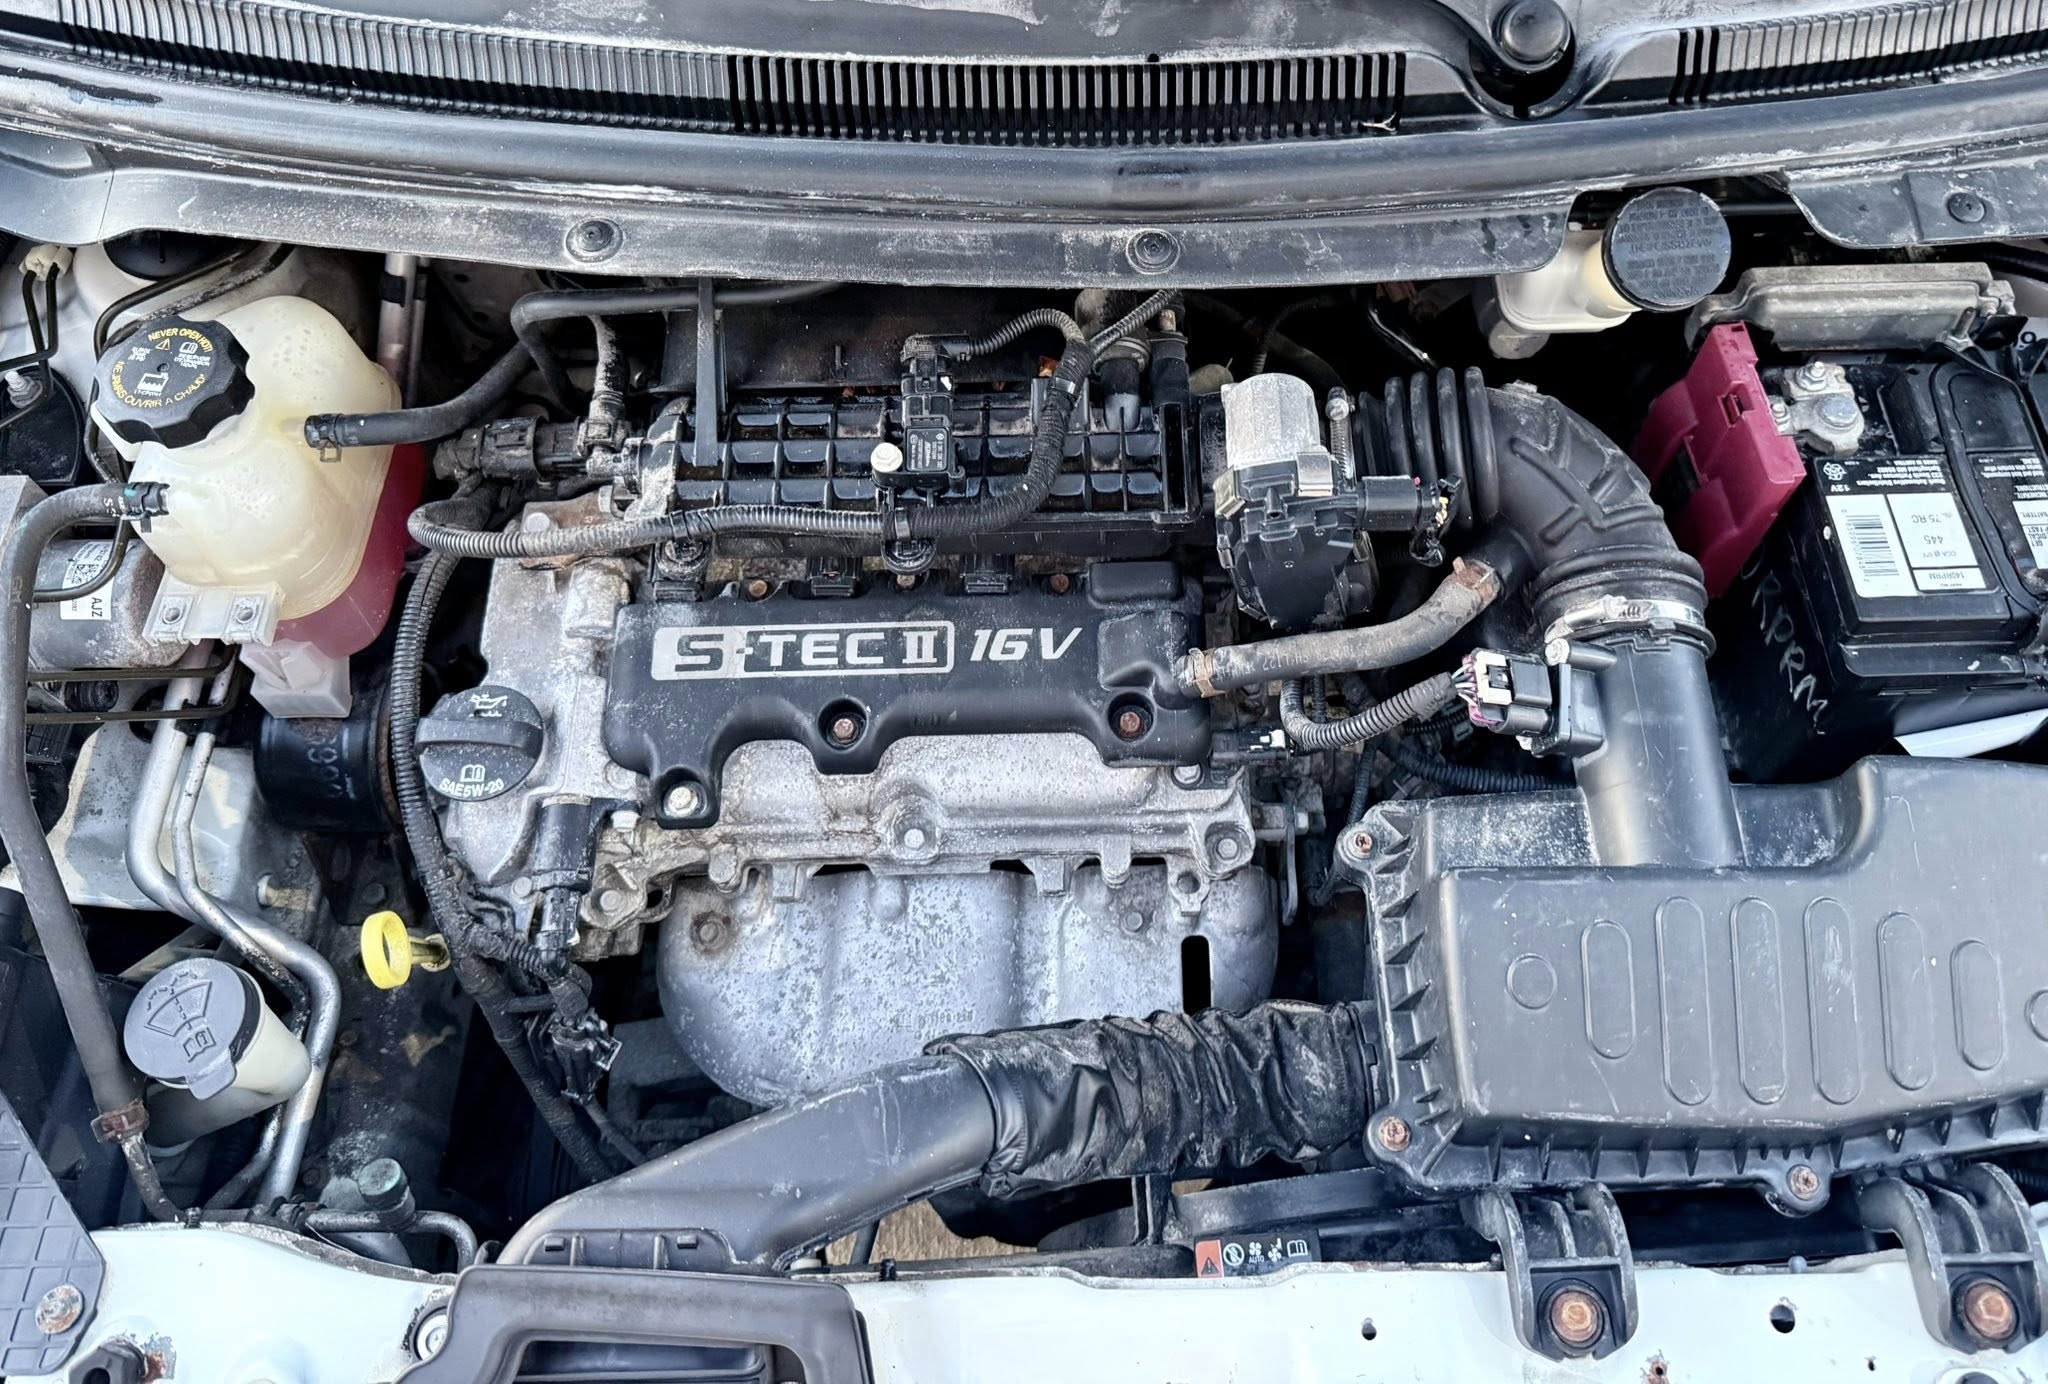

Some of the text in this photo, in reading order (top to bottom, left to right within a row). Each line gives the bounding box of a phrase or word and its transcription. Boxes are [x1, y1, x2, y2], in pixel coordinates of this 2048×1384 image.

[148, 328, 178, 341] NEVER
[179, 328, 202, 341] OPEN
[125, 395, 162, 408] OUVRIR
[1831, 484, 1850, 492] 12V
[1911, 514, 1927, 524] RC
[1923, 535, 1943, 545] 445
[91, 597, 102, 617] AJZ
[902, 630, 938, 664] II
[970, 627, 1082, 662] 16V
[440, 778, 505, 797] SAE5W-20
[1248, 1254, 1265, 1264] AUTO
